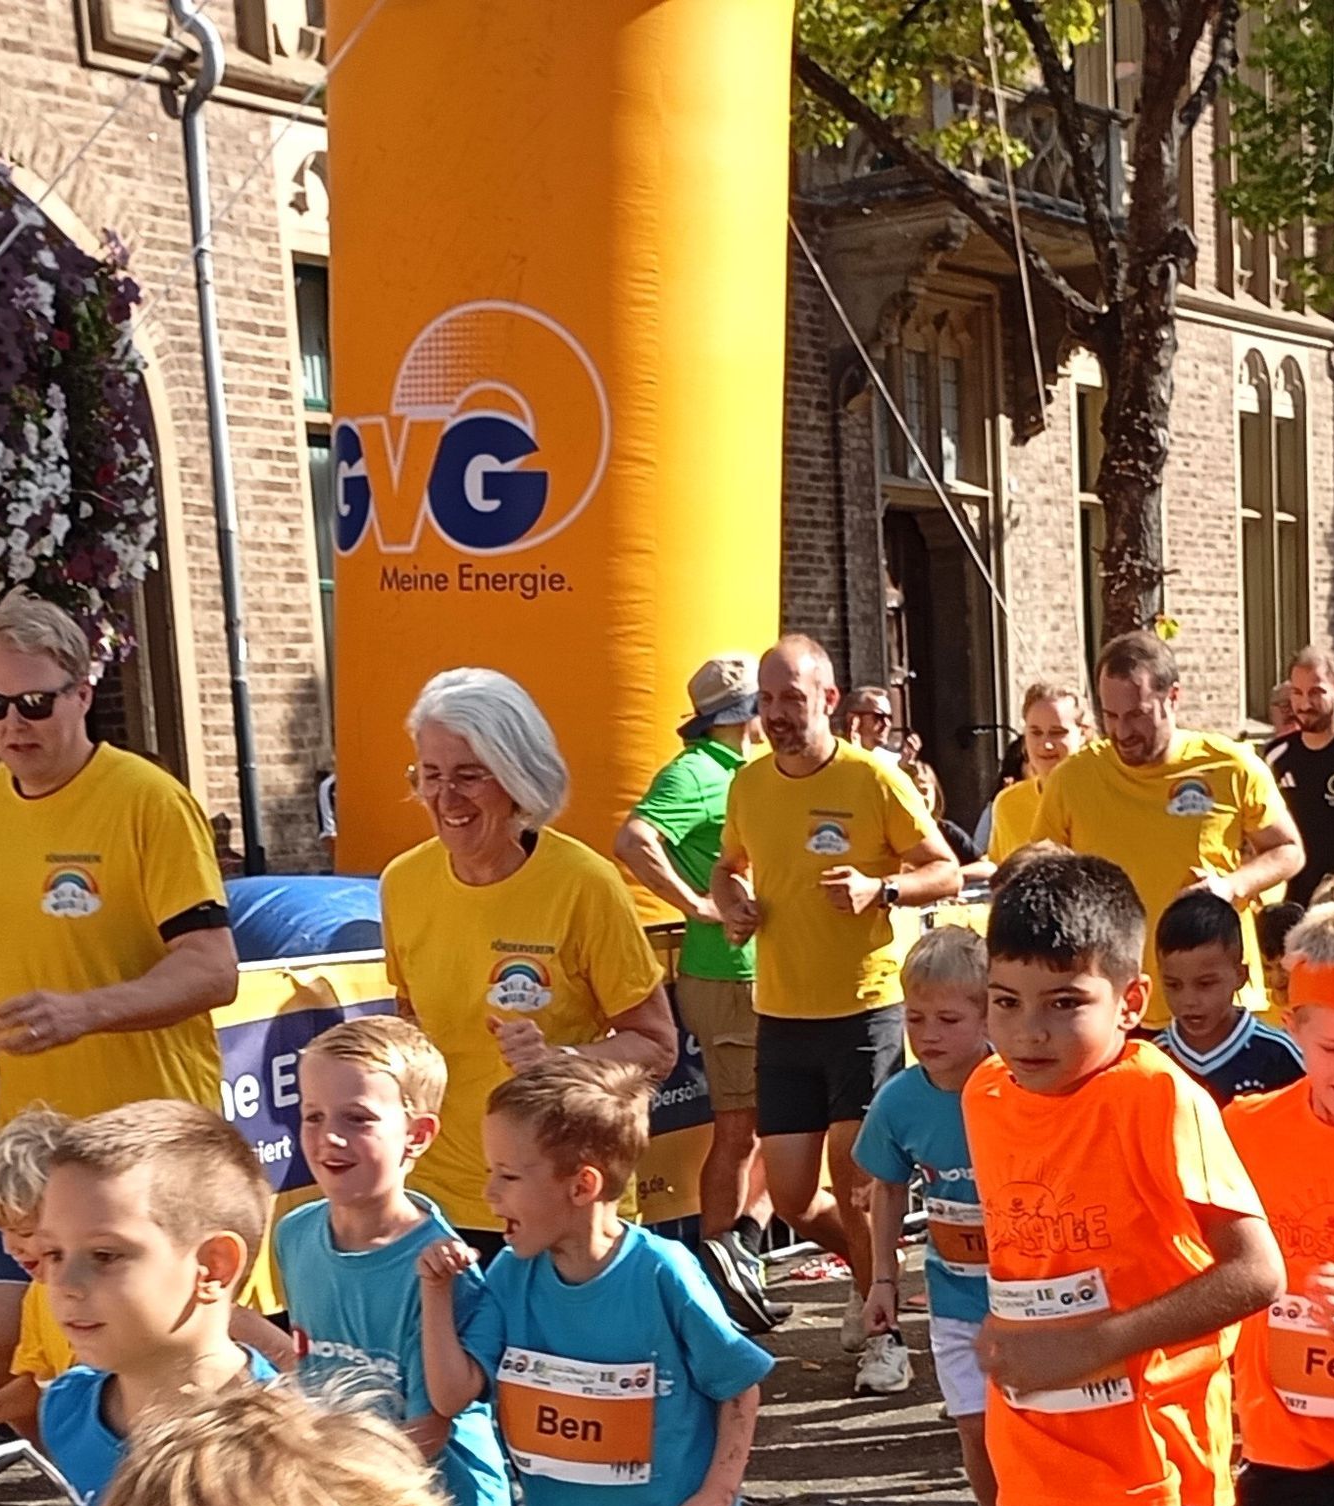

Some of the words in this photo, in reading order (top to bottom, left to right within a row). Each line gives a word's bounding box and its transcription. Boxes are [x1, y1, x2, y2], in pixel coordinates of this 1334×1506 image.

[332, 410, 548, 556] GVG
[380, 565, 449, 592] Meine
[458, 563, 574, 600] Energie.
[536, 1404, 603, 1442] Ben
